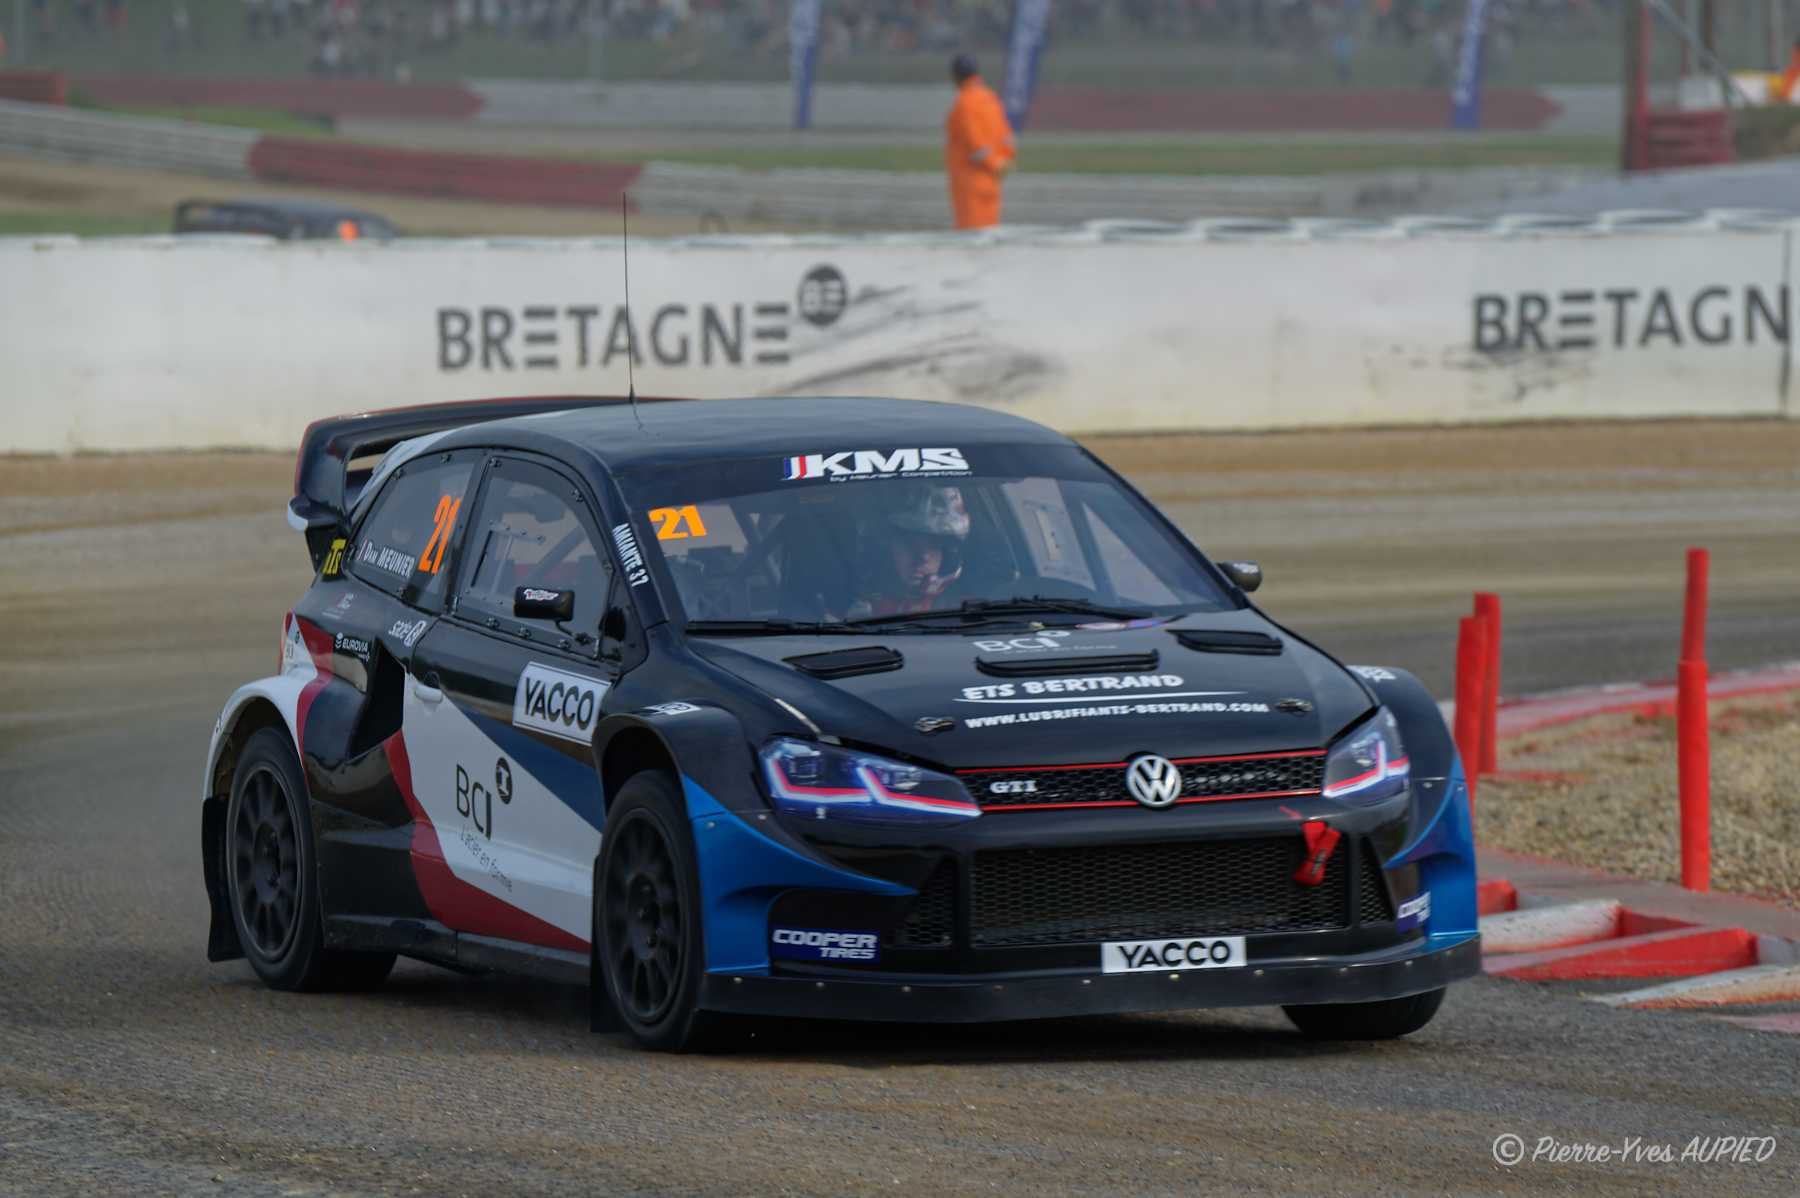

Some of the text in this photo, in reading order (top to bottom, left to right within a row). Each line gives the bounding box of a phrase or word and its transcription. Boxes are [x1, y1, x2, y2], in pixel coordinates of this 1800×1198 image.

[436, 303, 791, 371] BRETAGNE
[648, 504, 707, 540] 21
[418, 495, 462, 576] 21
[376, 547, 416, 577] MEUNIER
[629, 568, 650, 588] 37
[342, 637, 369, 653] EUROVIA
[961, 674, 1185, 700] ETS BERTRAND
[524, 676, 595, 731] YACCO
[965, 702, 1270, 728] WWW.LUBRIFIANTS-BERTRAND.COM
[989, 779, 1039, 794] GTI
[772, 929, 878, 949] COOPER
[819, 946, 877, 959] TIRES
[1118, 940, 1231, 969] YACCO
